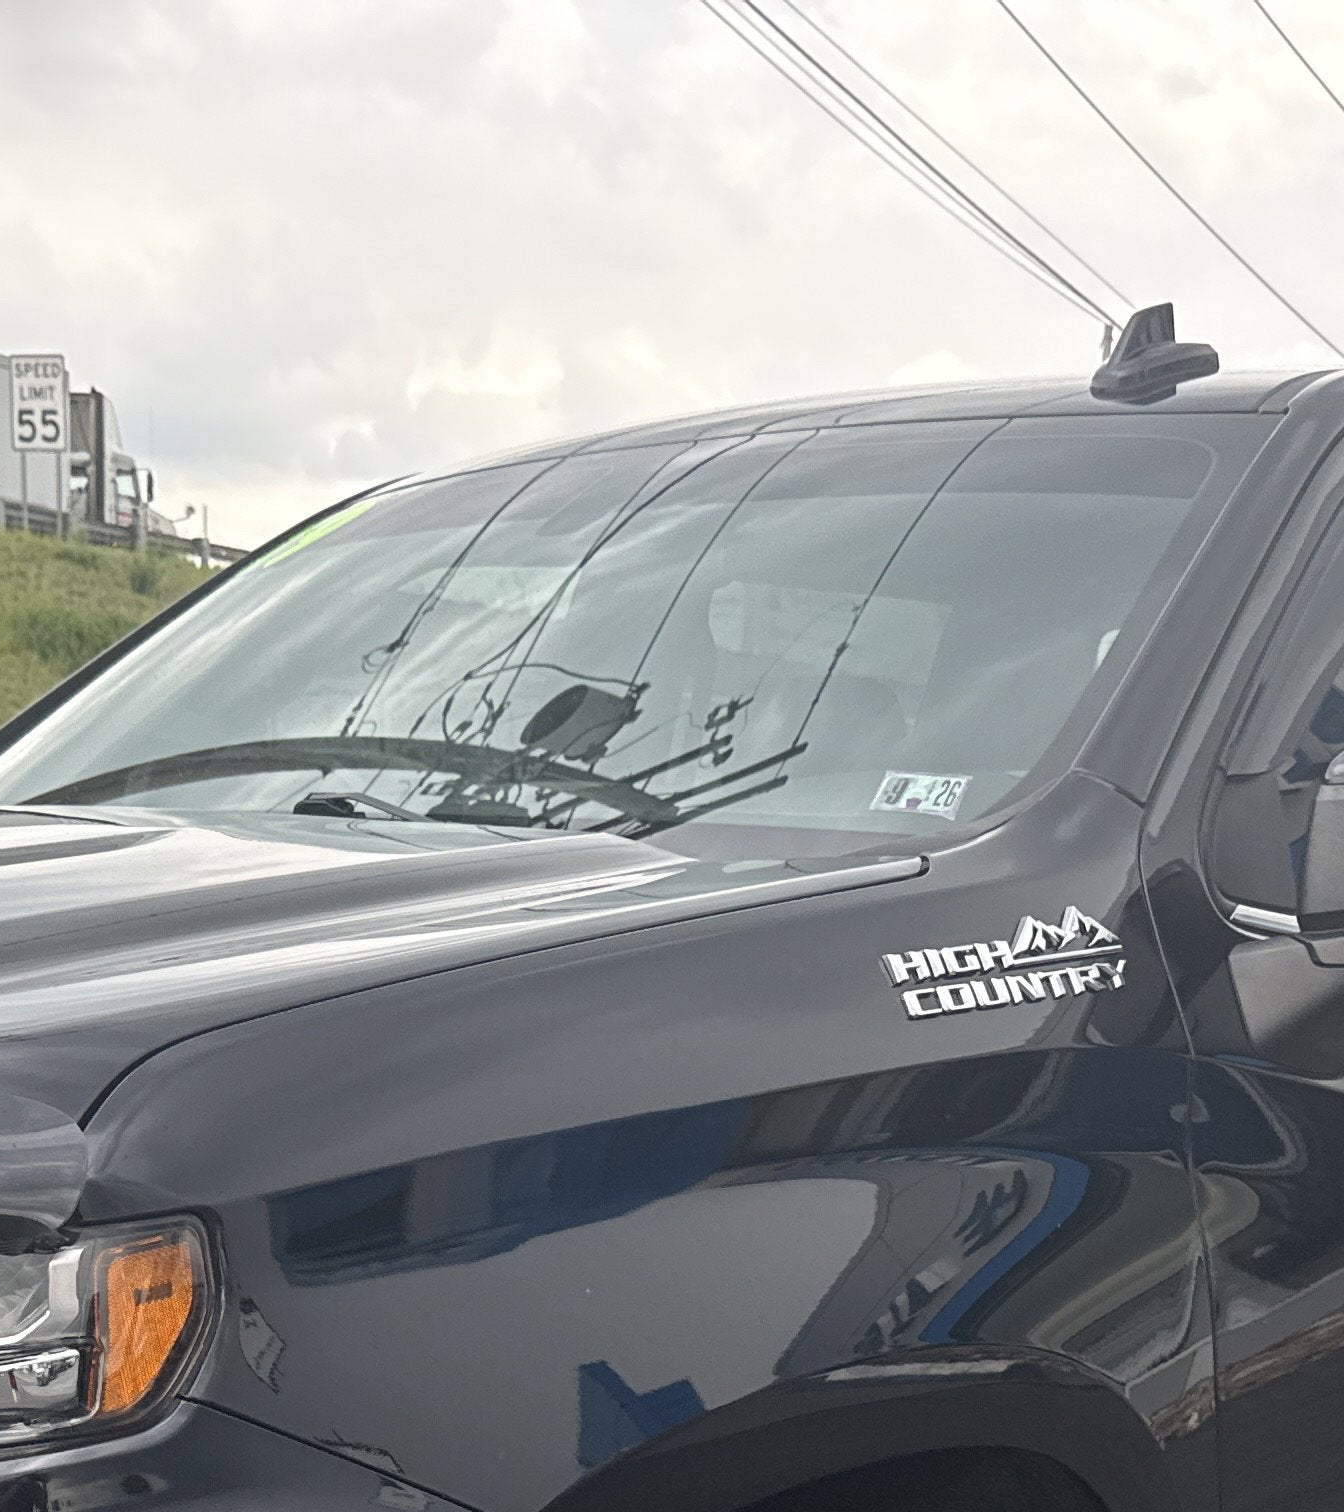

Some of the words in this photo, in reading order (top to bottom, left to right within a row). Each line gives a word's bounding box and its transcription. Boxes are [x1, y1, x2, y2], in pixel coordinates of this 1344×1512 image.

[14, 362, 62, 379] SPEED
[18, 384, 56, 402] LIMIT
[17, 408, 62, 444] 55
[931, 779, 963, 808] 26
[881, 939, 1017, 987] HIGH
[899, 958, 1128, 1020] COUNTRY
